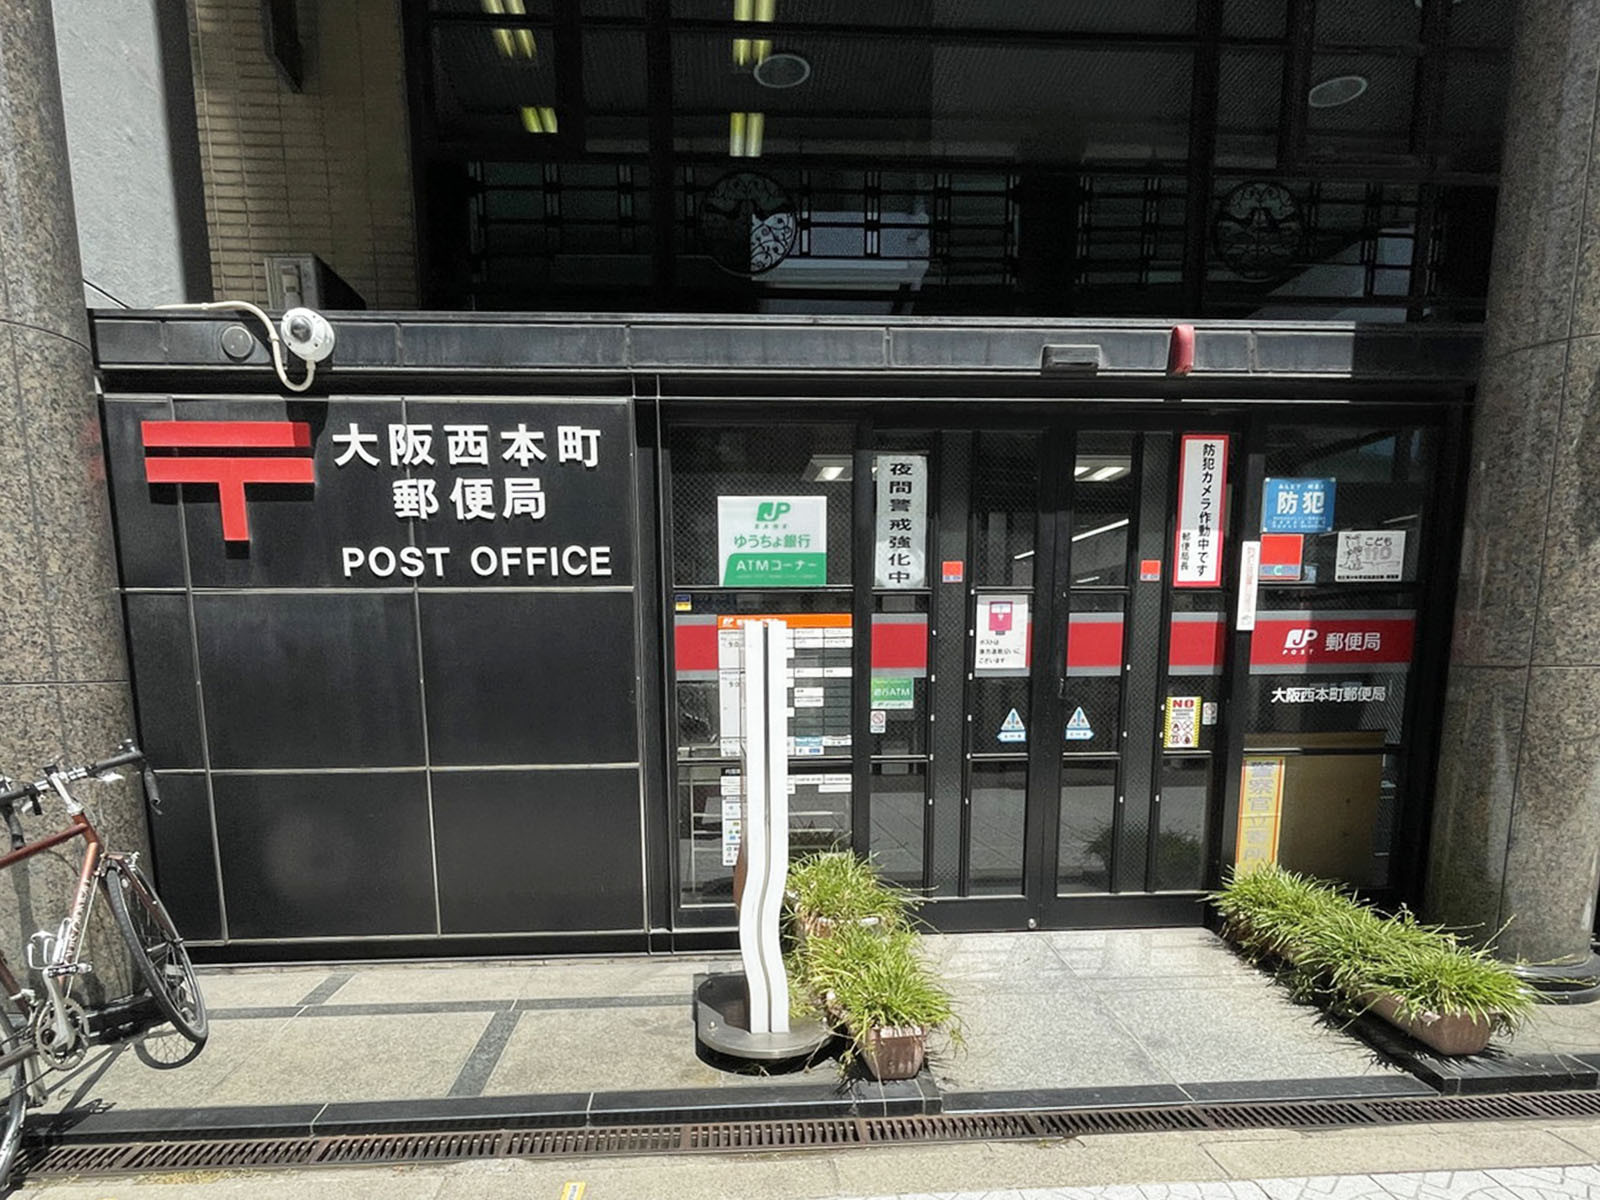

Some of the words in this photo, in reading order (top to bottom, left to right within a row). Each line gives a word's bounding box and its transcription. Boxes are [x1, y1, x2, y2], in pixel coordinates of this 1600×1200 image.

[332, 423, 600, 468] 大阪西本町
[392, 477, 547, 521] 郵便局
[1197, 443, 1216, 577] 防犯カメラ作動中です
[1276, 490, 1325, 515] 防犯
[888, 462, 913, 584] 夜間警戒強化中
[734, 534, 811, 549] ゆうちょ銀行
[1364, 536, 1393, 547] こども
[342, 546, 450, 578] POST
[470, 545, 612, 577] OFFICE
[736, 559, 817, 572] ATMコーナー
[1325, 632, 1381, 652] 郵便局
[1172, 699, 1195, 708] NO
[1271, 685, 1386, 703] 大阪西本町郵便局
